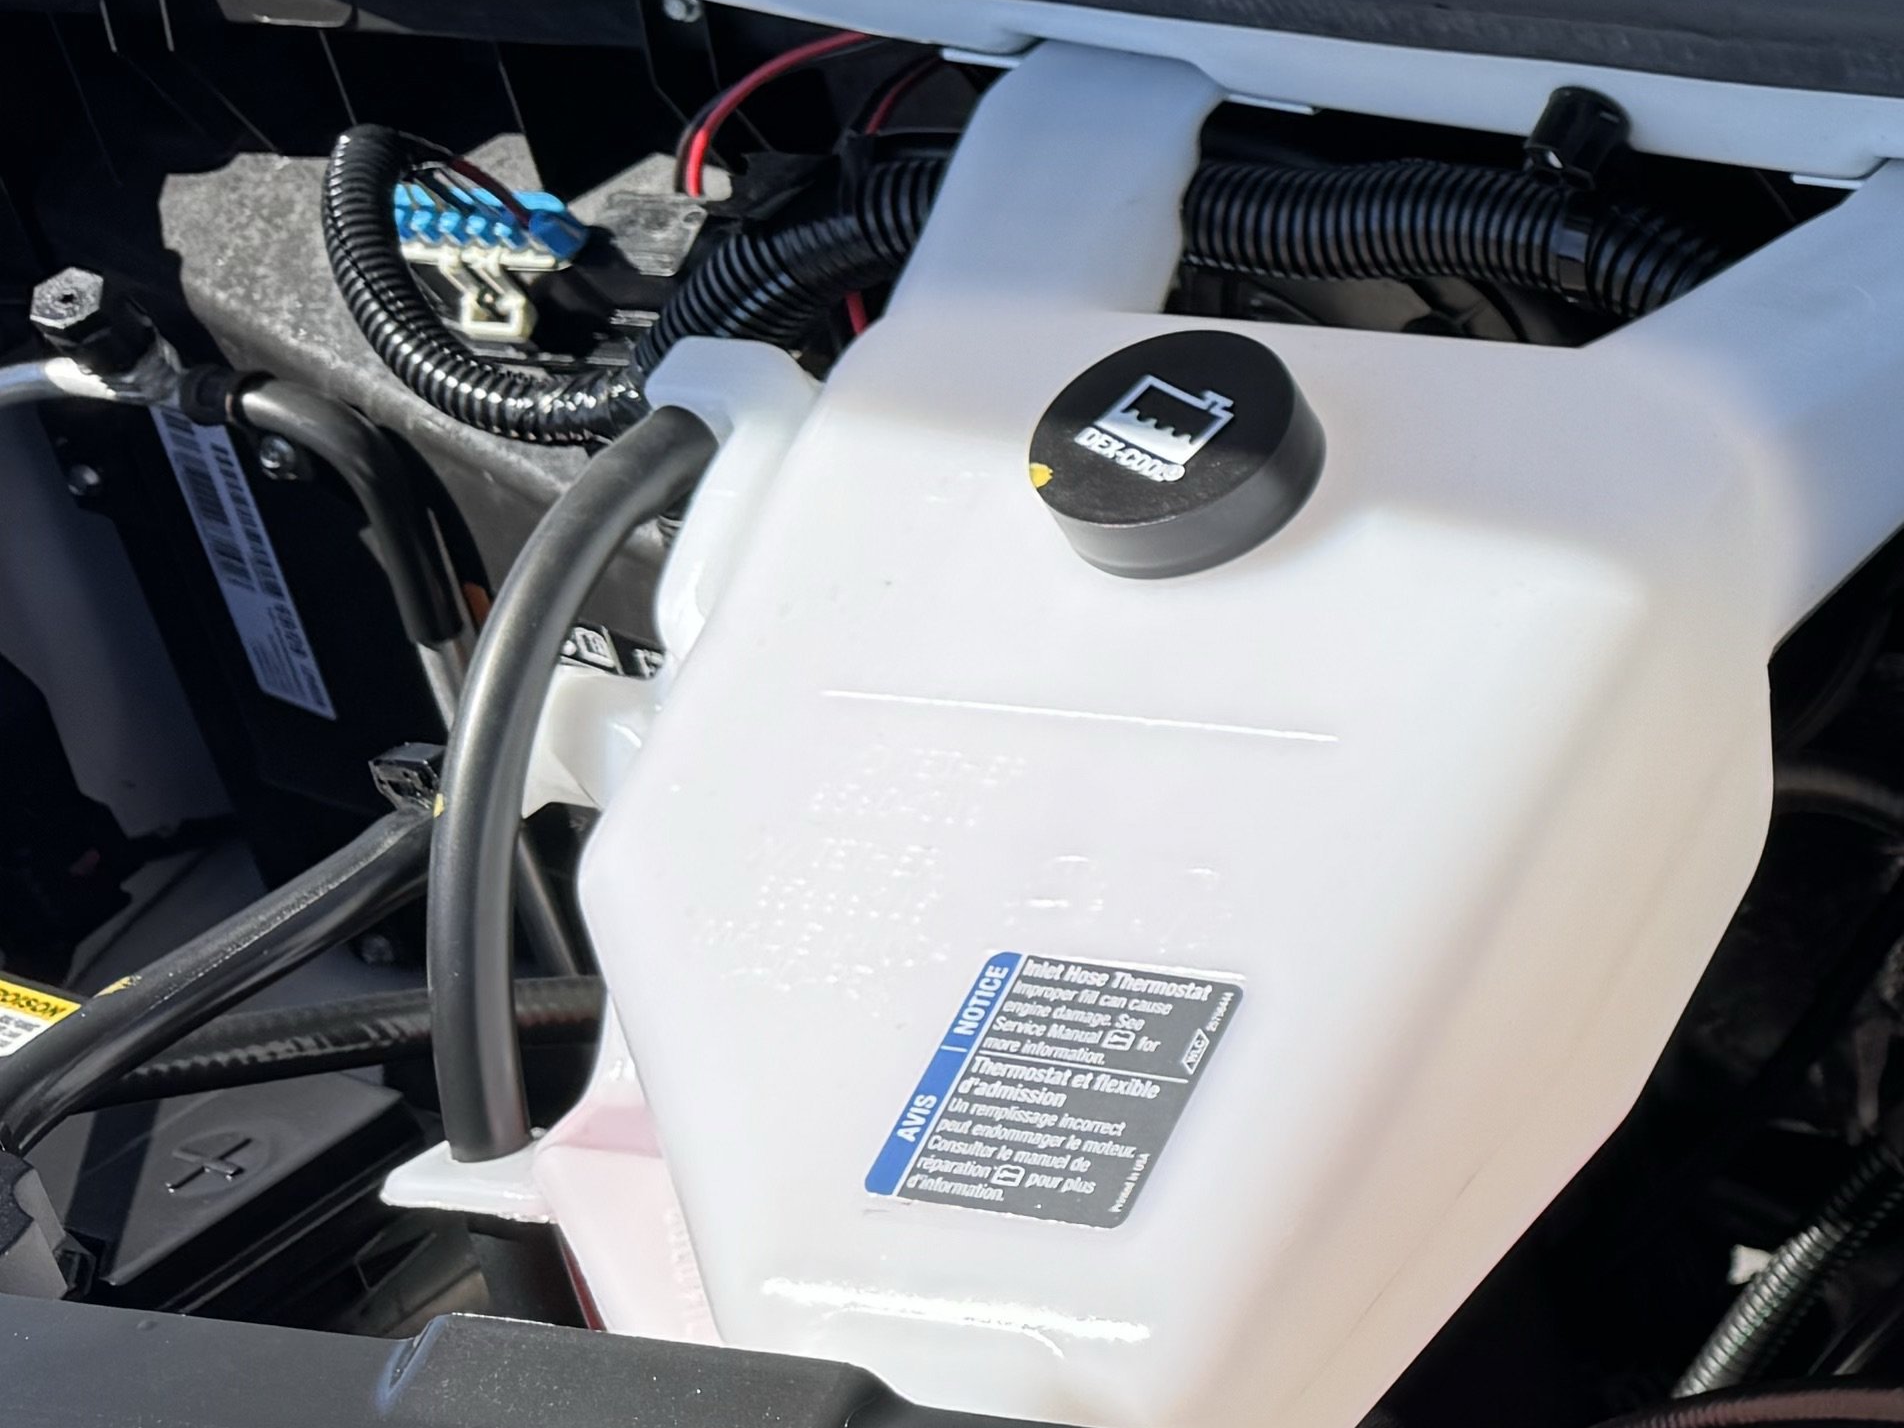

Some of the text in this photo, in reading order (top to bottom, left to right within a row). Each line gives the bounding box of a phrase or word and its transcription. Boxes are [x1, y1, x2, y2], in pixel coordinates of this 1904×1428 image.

[1012, 979, 1173, 1016] Improper fill can cause
[1022, 959, 1213, 1002] Inlet Hose Thermostat
[992, 1015, 1161, 1052] Service Manual for
[1002, 1000, 1145, 1031] engine damage. See
[896, 963, 1010, 1143] AVIS NOTICE
[982, 1036, 1105, 1066] more information.
[958, 1076, 1067, 1108] d'admission
[971, 1056, 1160, 1100] Thermostat et flexible
[948, 1097, 1126, 1137] Un remplissage incorrect
[927, 1134, 1091, 1173] Consulter le manuel de
[935, 1118, 1137, 1160] peut endommager le moteur.
[906, 1173, 1005, 1202] d'information.
[1024, 1172, 1064, 1189] pour
[1060, 1176, 1096, 1194] plus
